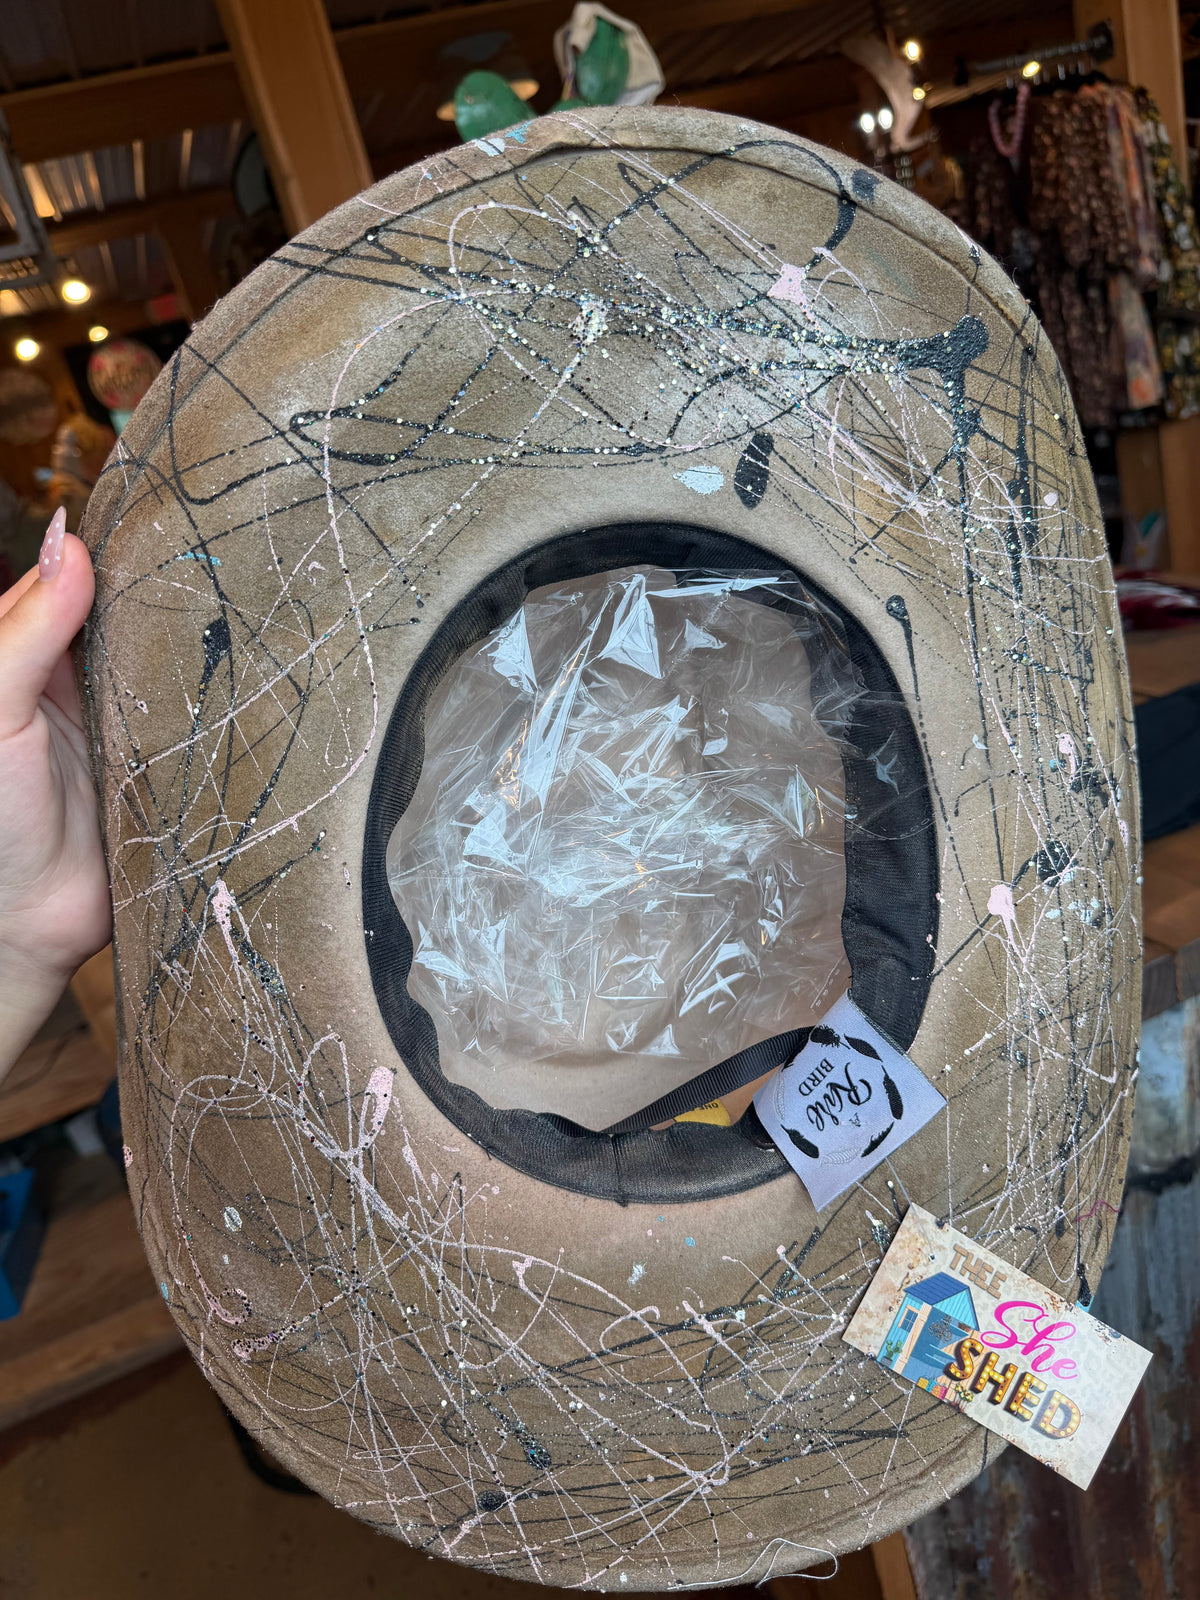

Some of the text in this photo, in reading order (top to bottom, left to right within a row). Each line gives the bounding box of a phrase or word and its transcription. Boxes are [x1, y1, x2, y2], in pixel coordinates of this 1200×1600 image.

[798, 1057, 835, 1097] BIRD
[806, 1062, 873, 1132] Rare
[848, 1112, 862, 1128] A
[949, 1243, 1007, 1300] THEE
[980, 1300, 1079, 1380] She
[943, 1338, 1081, 1440] SHED
